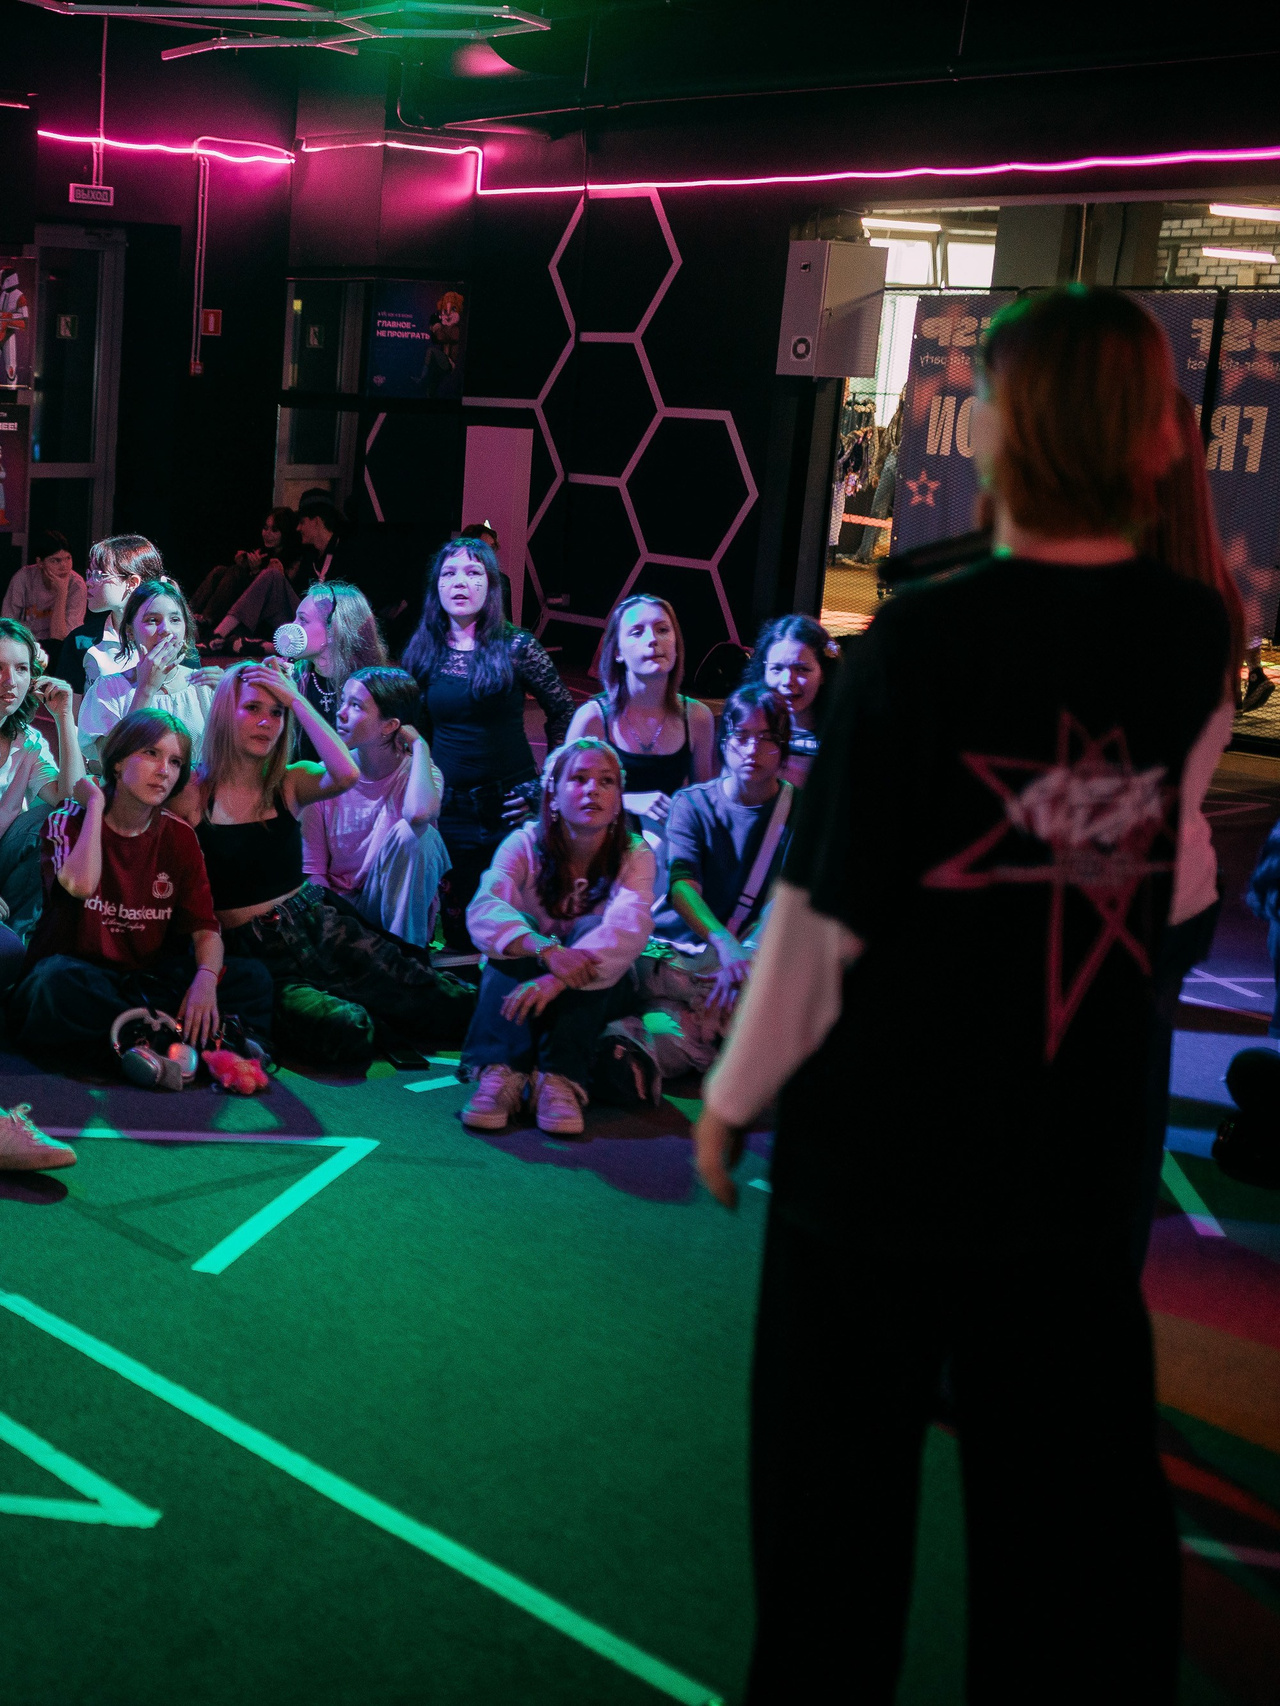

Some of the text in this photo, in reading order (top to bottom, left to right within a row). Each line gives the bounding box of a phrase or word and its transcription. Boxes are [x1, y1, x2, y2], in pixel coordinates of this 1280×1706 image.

[76, 189, 108, 201] ВЫХОД
[377, 320, 411, 329] ГЛАВНОЕ
[387, 331, 430, 340] ПРОИГРАТЬ
